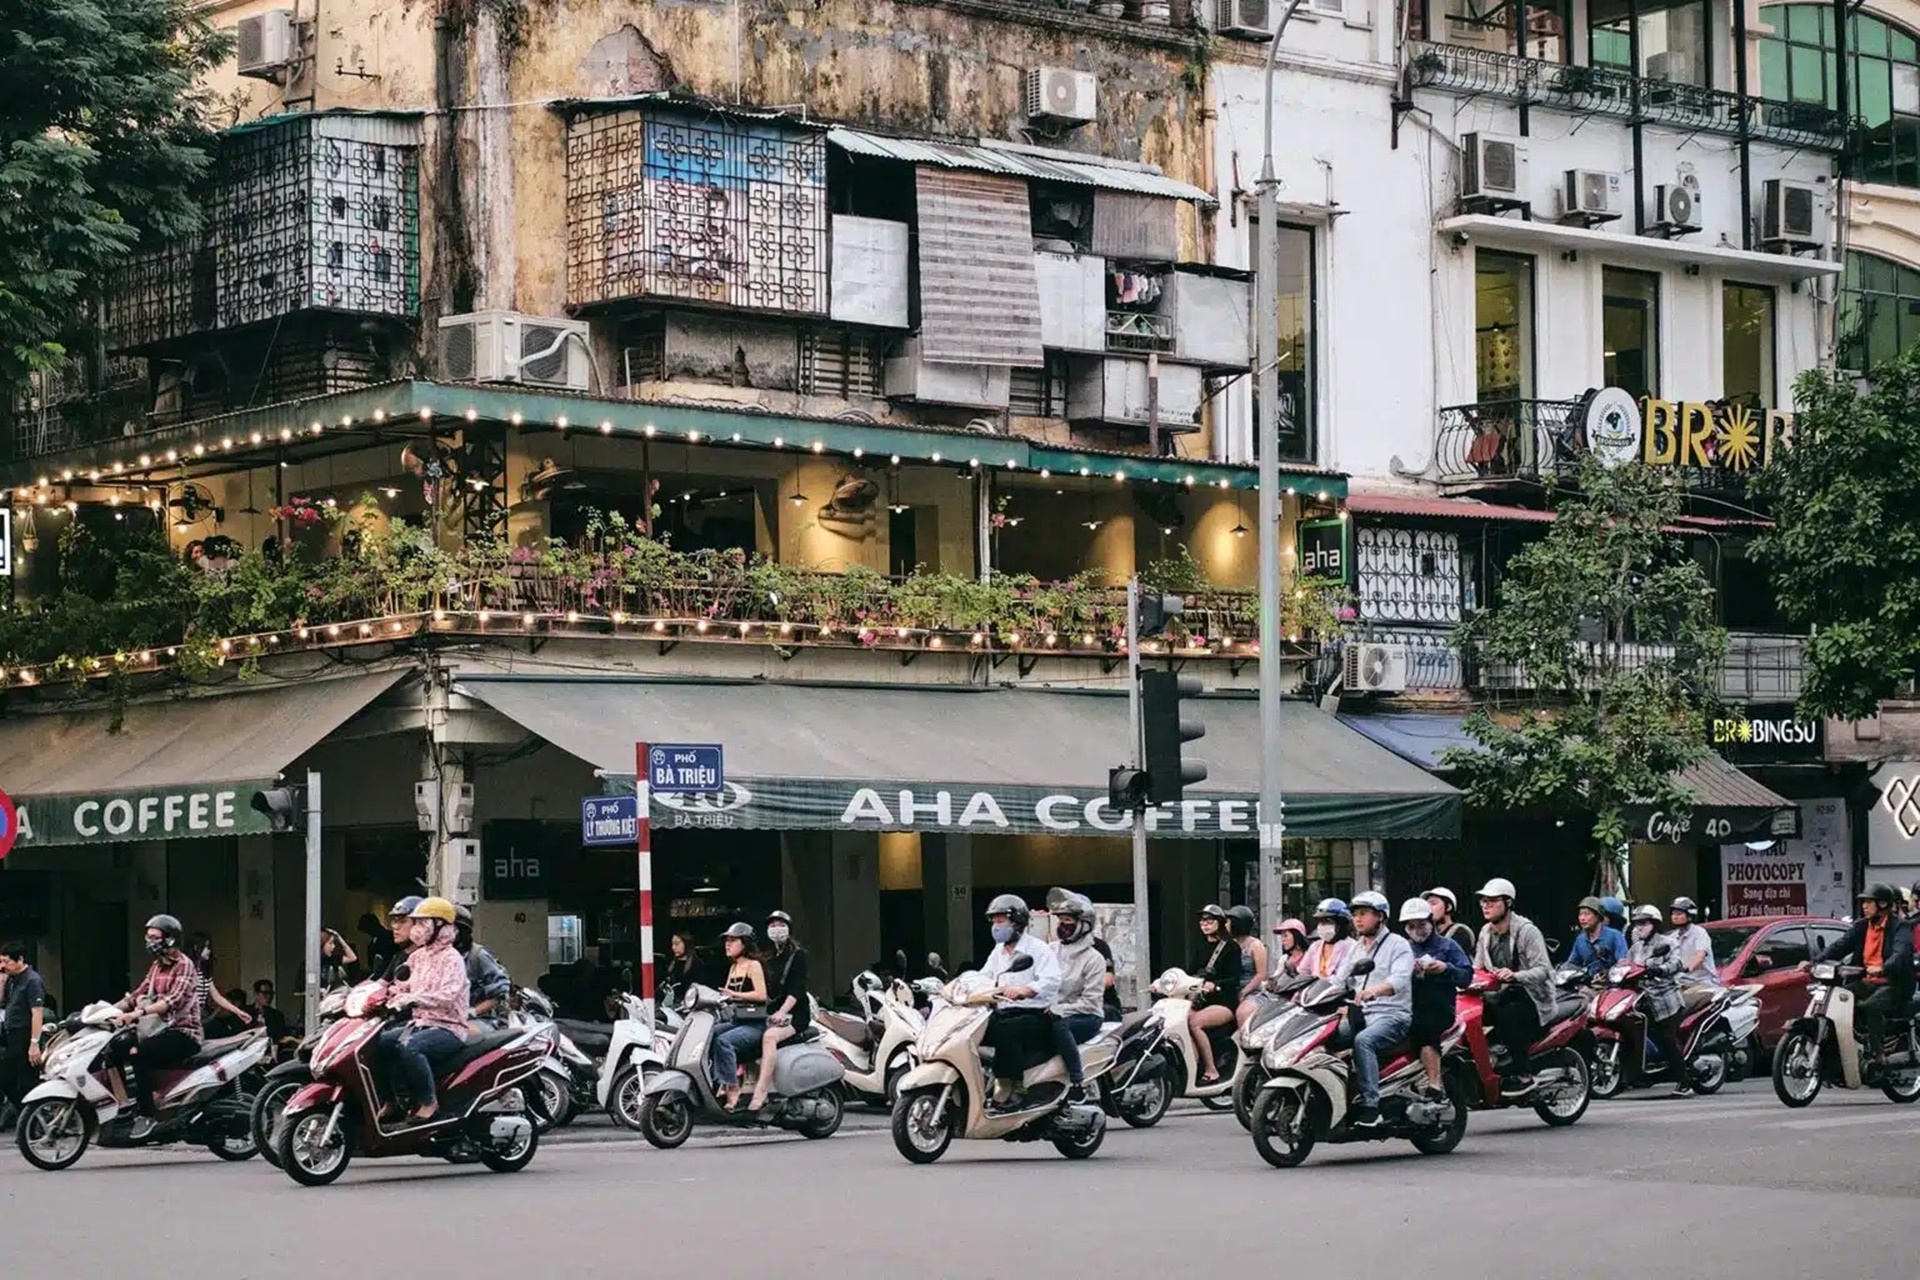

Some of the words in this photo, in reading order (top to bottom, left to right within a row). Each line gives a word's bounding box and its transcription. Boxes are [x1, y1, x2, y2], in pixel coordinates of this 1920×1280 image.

[1305, 540, 1340, 568] aha
[674, 750, 697, 763] PHỐ
[656, 764, 675, 784] BÀ
[677, 764, 716, 788] TRIỆU
[73, 791, 236, 837] COFFEE
[601, 800, 619, 814] PHỐ
[840, 788, 1009, 827] AHA
[1034, 794, 1286, 832] COFFE
[1705, 818, 1731, 837] 40
[495, 846, 540, 877] aha
[1726, 862, 1805, 881] PHOTOCOPY
[514, 912, 526, 923] 40
